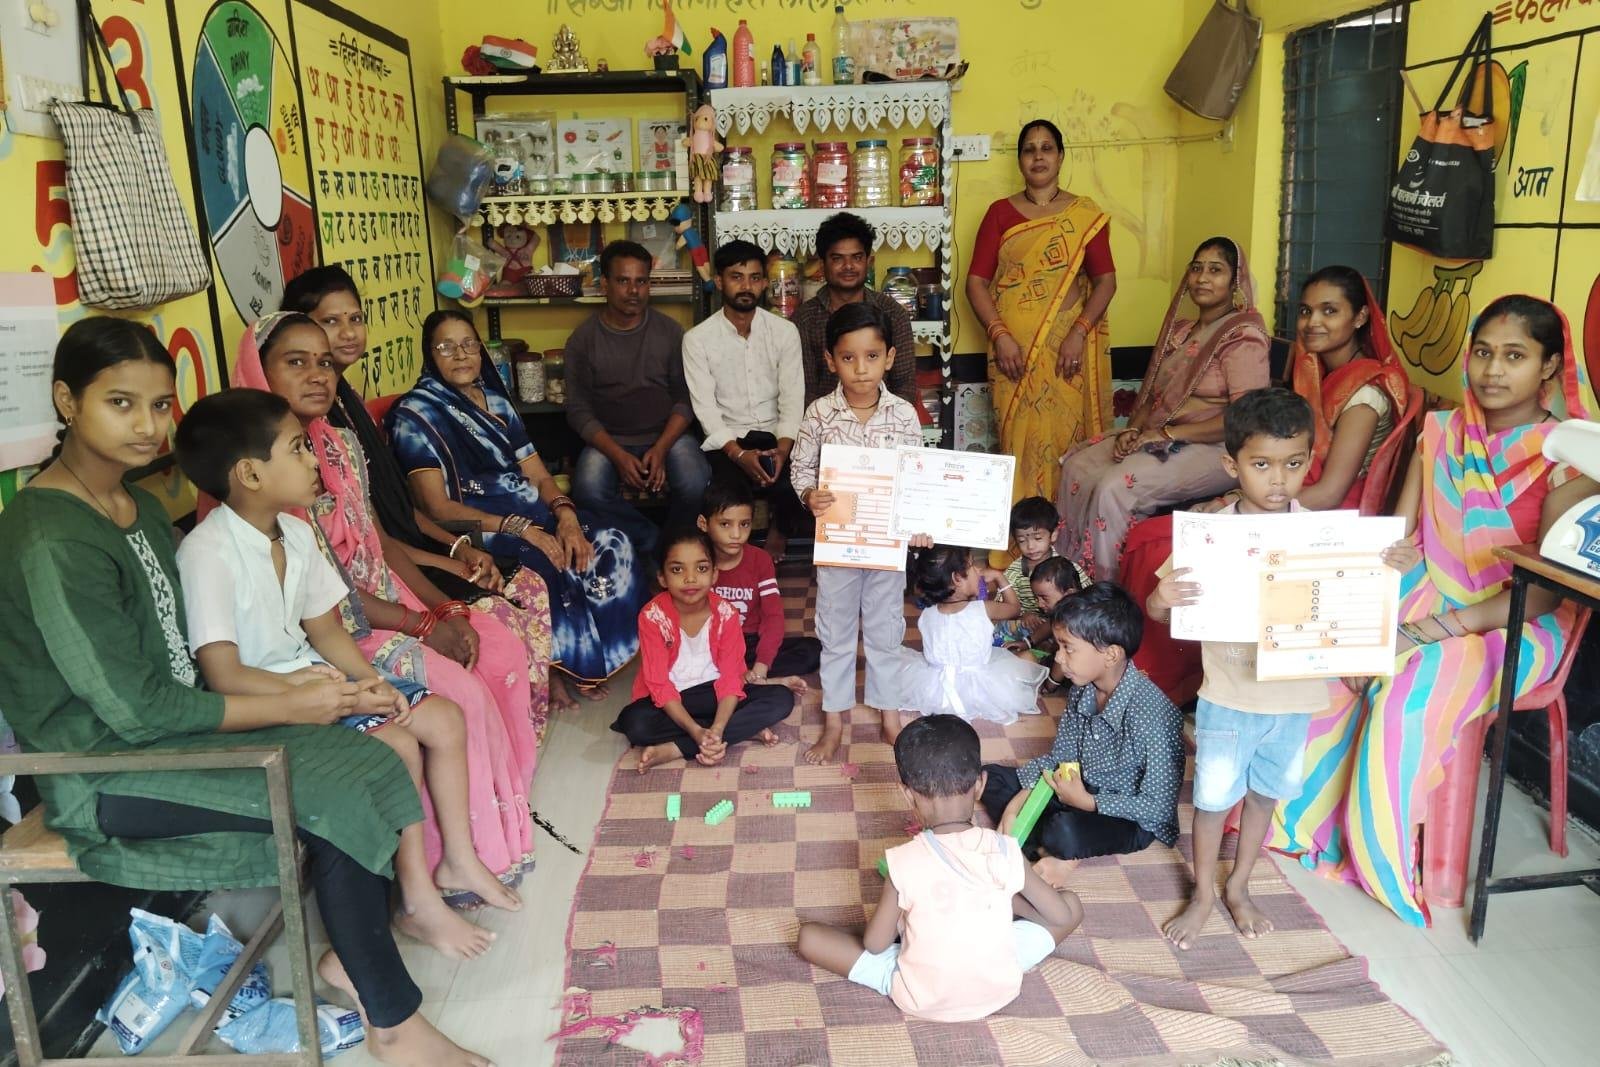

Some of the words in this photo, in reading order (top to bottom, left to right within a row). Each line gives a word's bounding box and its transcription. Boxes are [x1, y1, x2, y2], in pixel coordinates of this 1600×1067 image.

[307, 66, 320, 98] अ
[325, 72, 339, 106] आ
[279, 104, 298, 156] SUNNY
[318, 170, 330, 199] क
[333, 171, 345, 200] ख
[346, 171, 357, 197] ग
[1514, 166, 1554, 198] आम
[335, 211, 344, 244] ट
[347, 212, 355, 241] ठ
[358, 212, 367, 244] ड
[358, 258, 368, 286] फ
